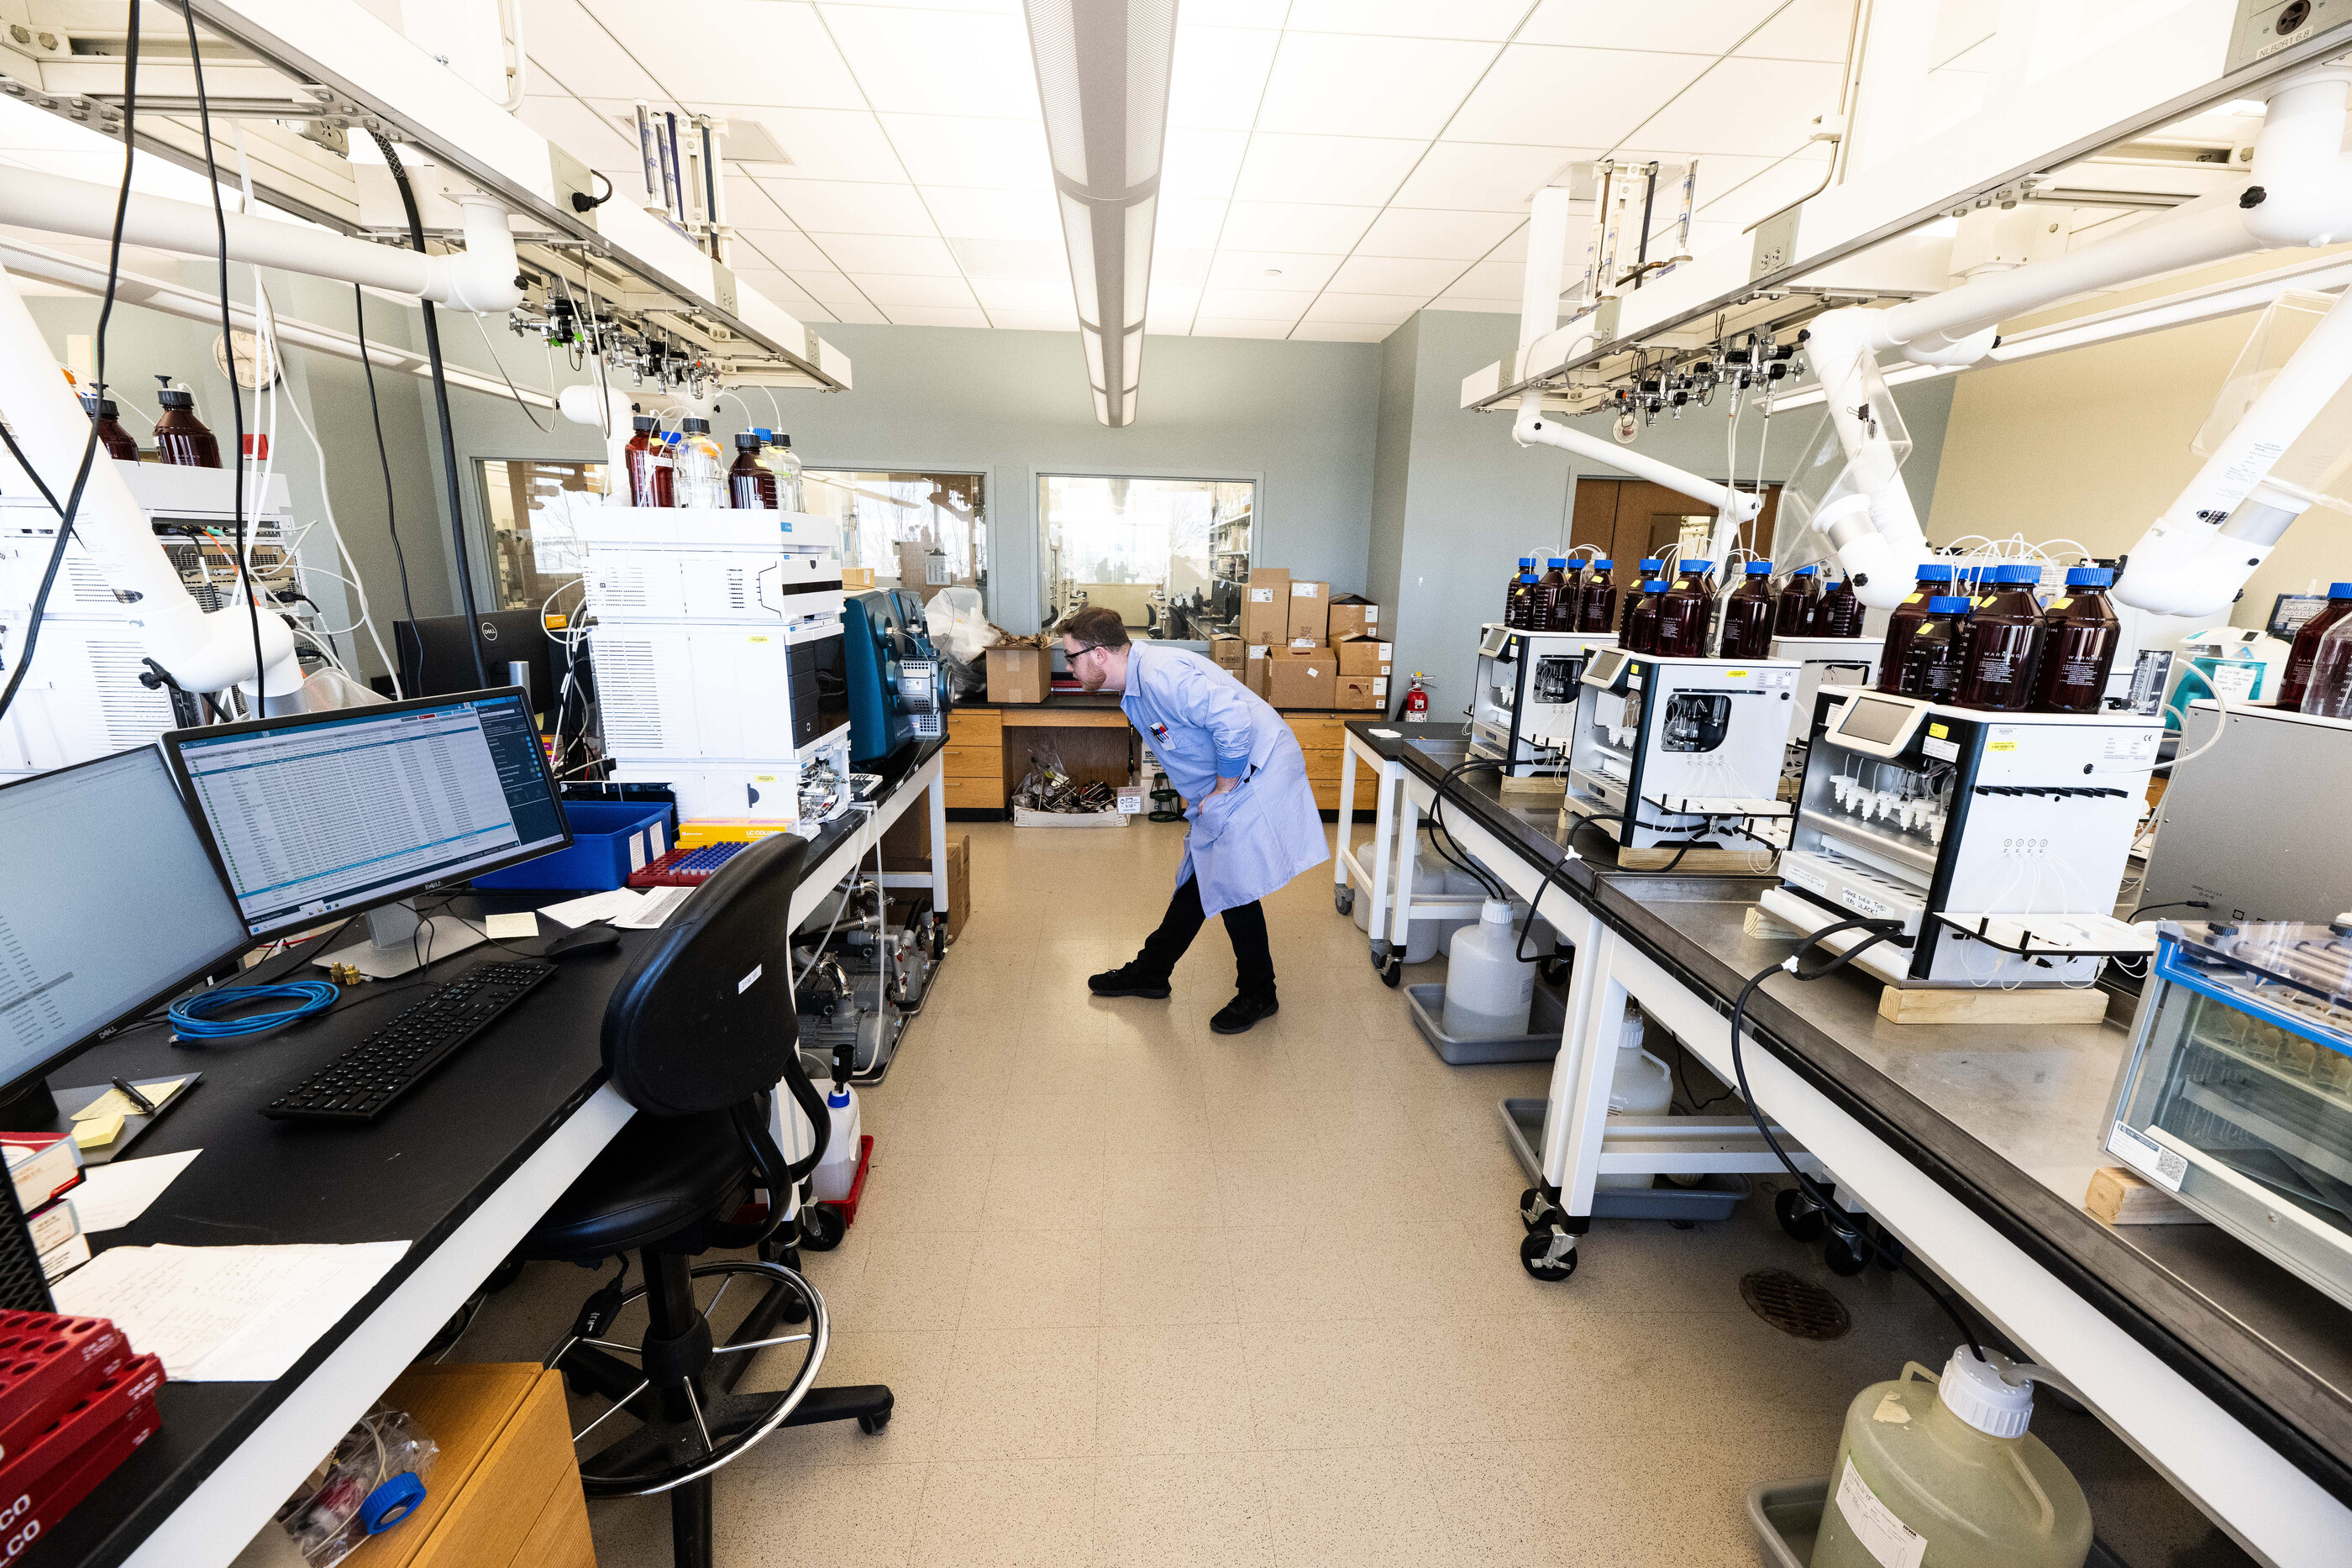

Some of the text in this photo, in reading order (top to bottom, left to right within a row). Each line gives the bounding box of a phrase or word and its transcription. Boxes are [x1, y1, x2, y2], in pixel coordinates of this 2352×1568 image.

[2259, 29, 2310, 57] NLB2R1 6.8
[261, 911, 283, 921] Acquisition
[98, 1026, 117, 1039] DELL
